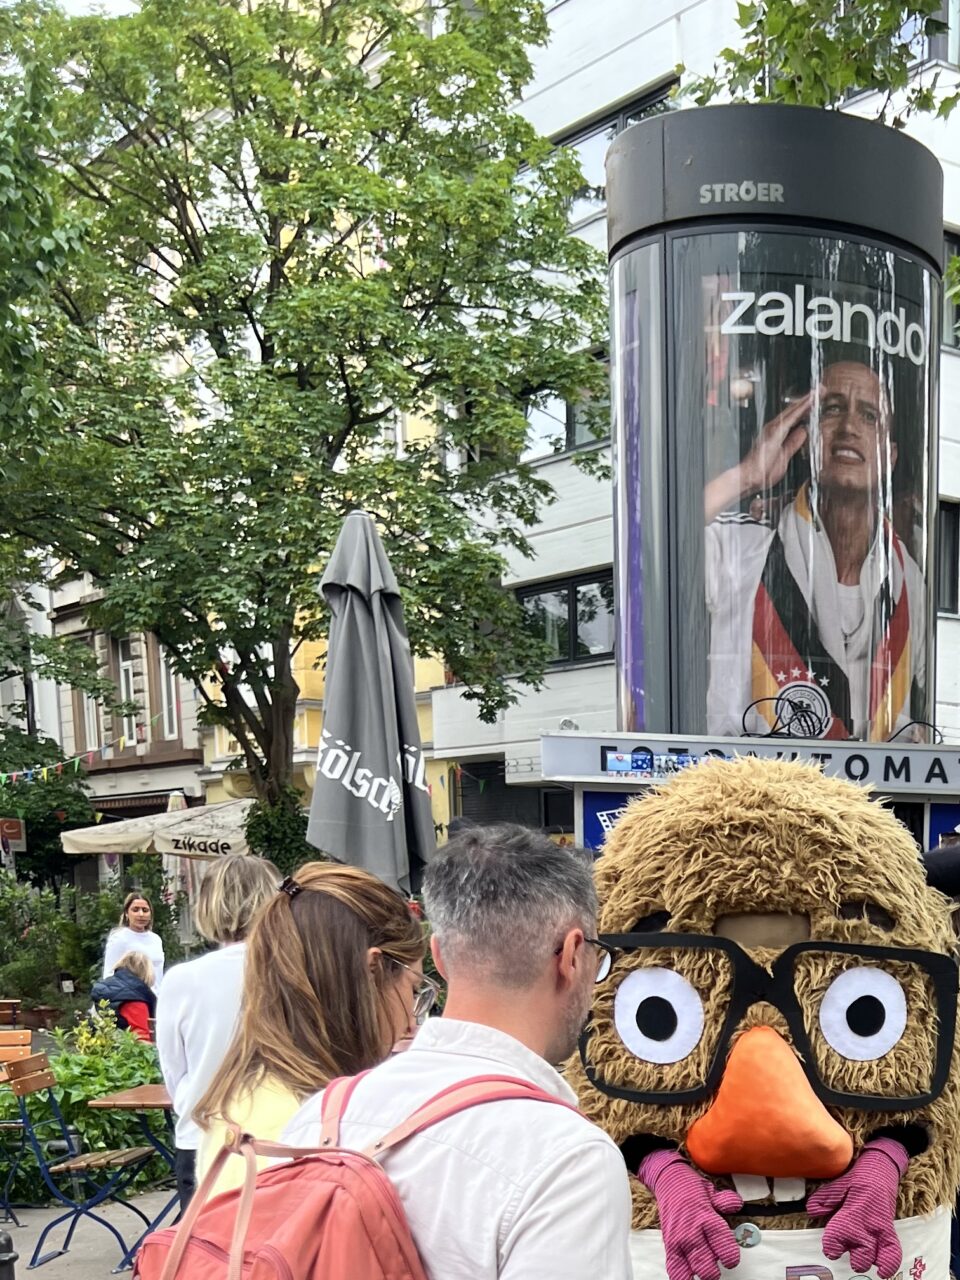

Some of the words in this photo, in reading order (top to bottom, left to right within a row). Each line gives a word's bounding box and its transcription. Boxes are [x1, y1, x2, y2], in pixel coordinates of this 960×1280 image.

[699, 180, 784, 204] STRÖER
[720, 284, 926, 366] zalando
[171, 836, 232, 855] zikade
